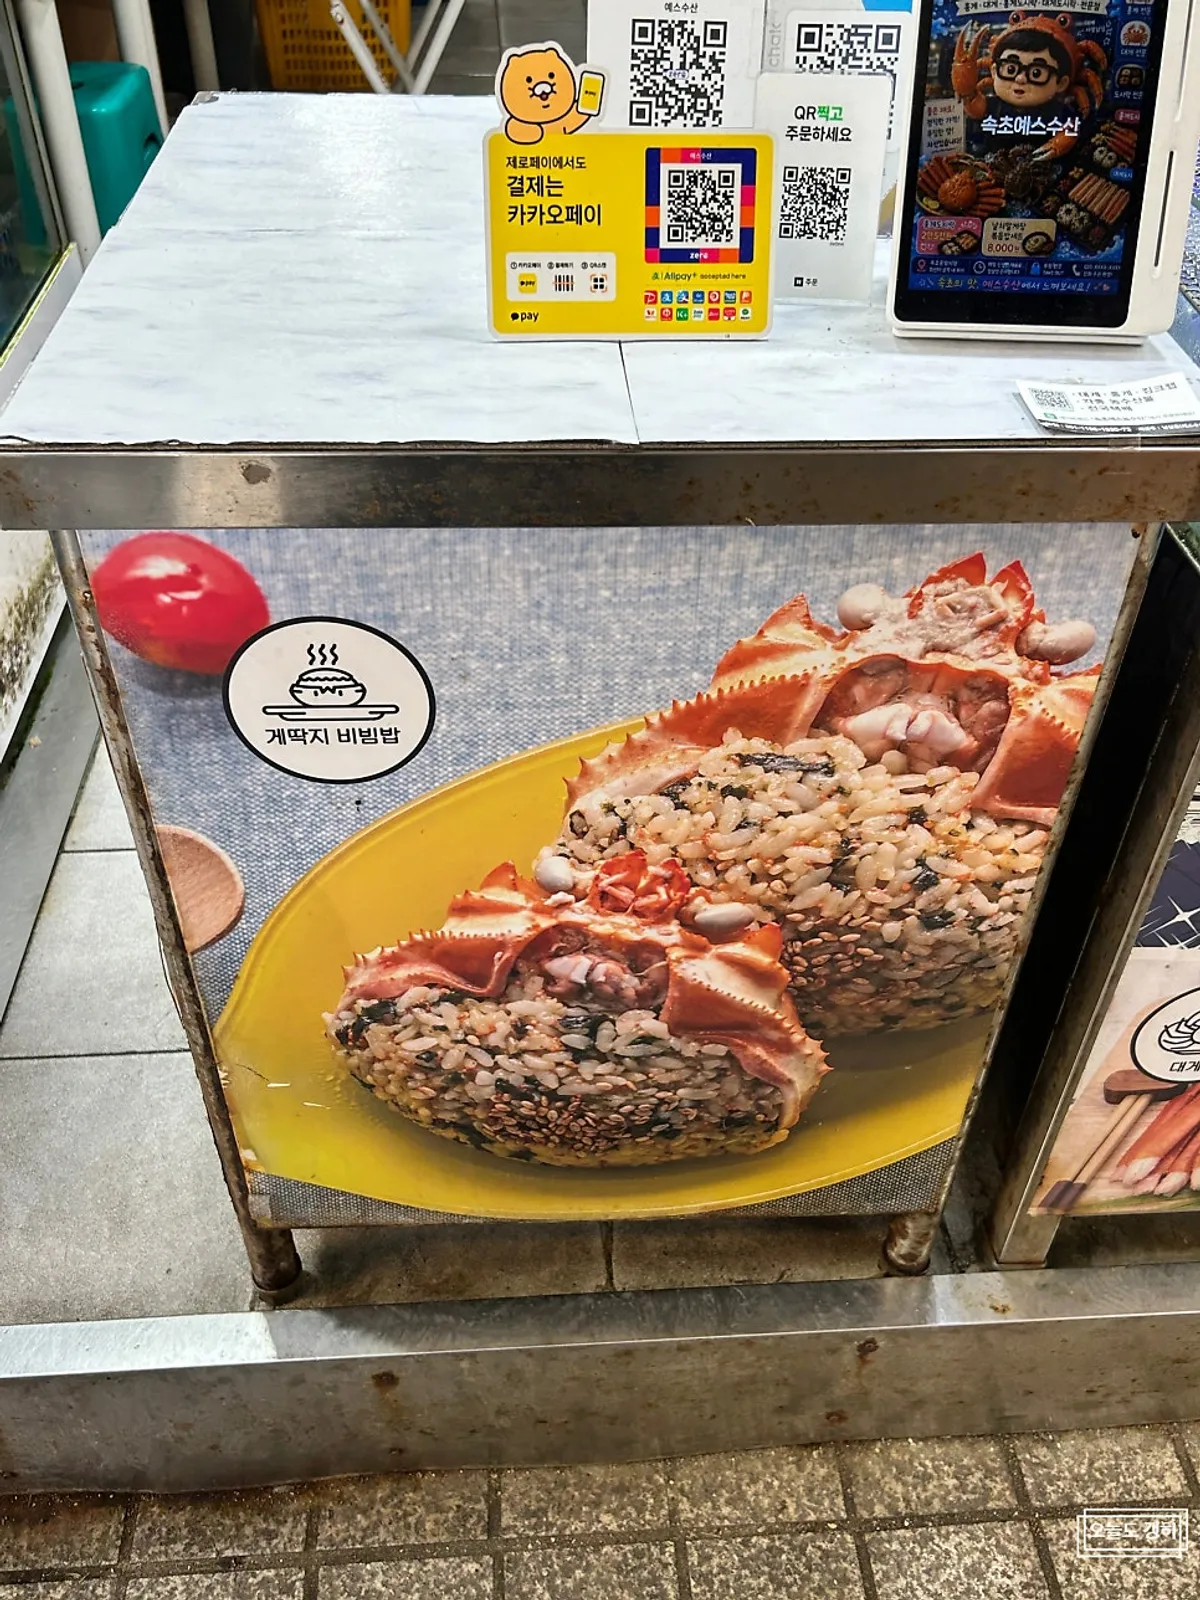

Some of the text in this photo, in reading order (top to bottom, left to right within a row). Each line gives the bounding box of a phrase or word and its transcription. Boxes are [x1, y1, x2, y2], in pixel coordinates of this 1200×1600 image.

[664, 1, 698, 13] 예스수산
[794, 105, 843, 121] QR찍고
[785, 126, 852, 143] 주문하세요
[981, 115, 1081, 138] 속초예스수산
[505, 156, 587, 170] 제로페이에서도
[506, 175, 565, 198] 결제는
[507, 204, 602, 227] 카카오페이
[689, 252, 709, 260] zero
[699, 273, 731, 281] accepted
[520, 312, 540, 323] pay
[265, 727, 401, 746] 게딱지 비빔밥
